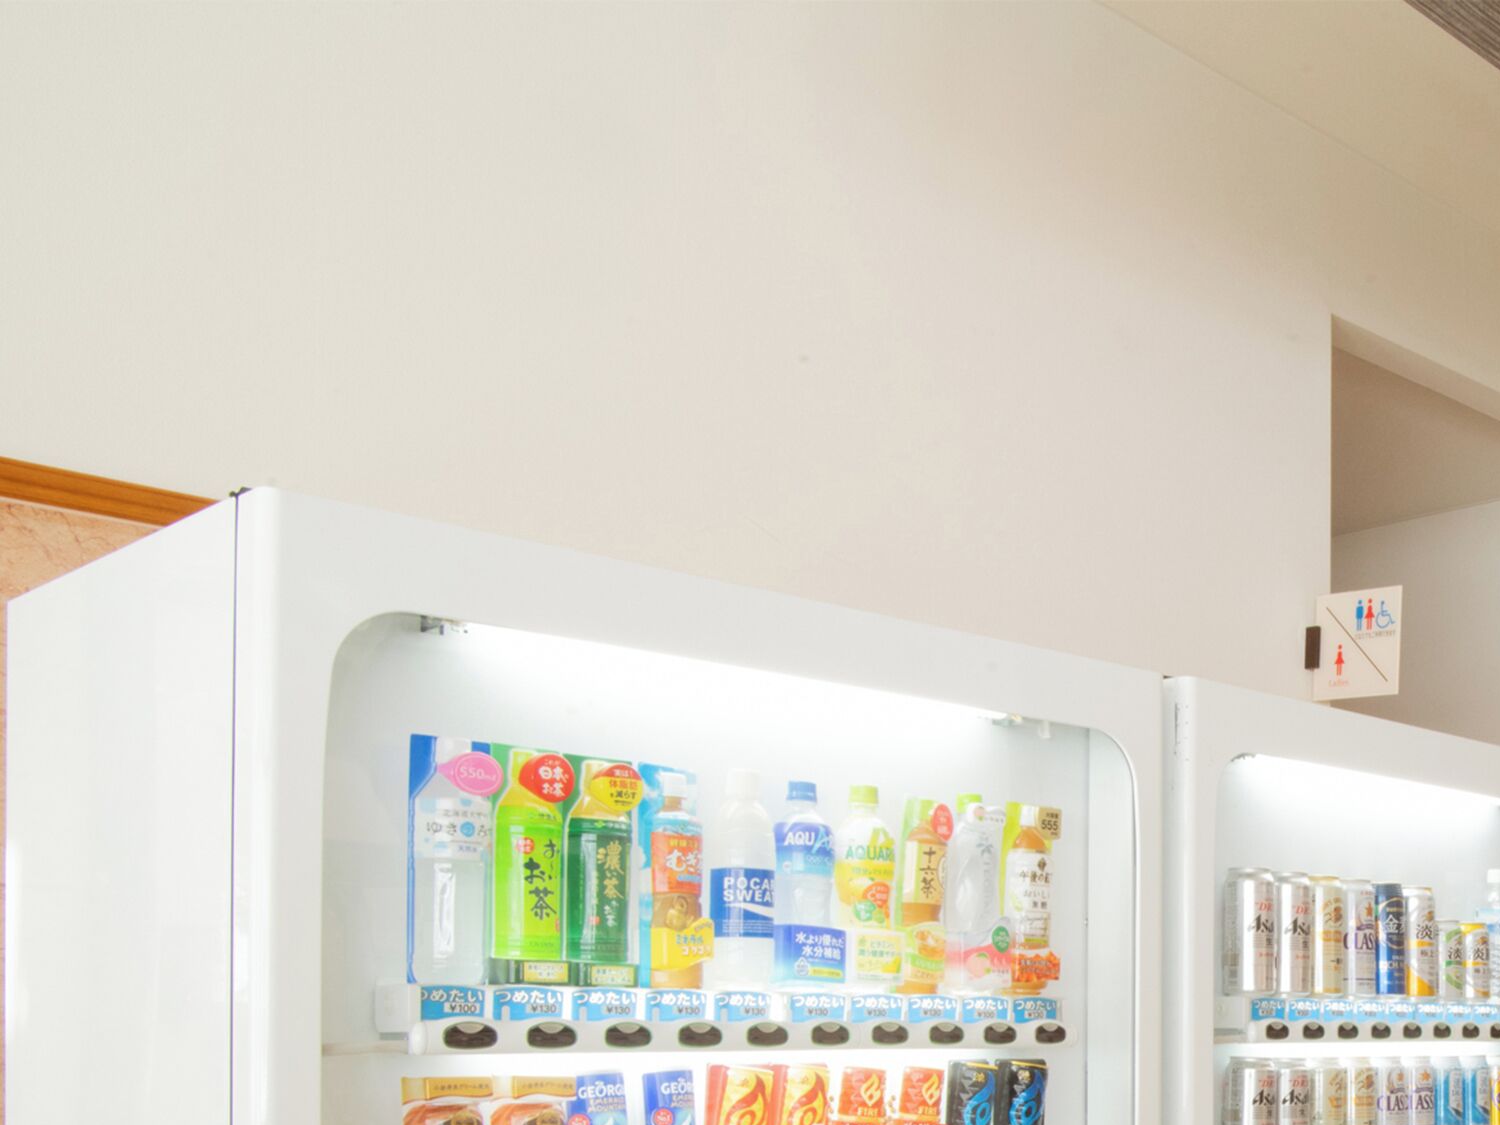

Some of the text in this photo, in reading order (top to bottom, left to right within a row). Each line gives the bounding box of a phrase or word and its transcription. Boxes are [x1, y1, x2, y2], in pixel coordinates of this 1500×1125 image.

[523, 856, 558, 921] お茶
[496, 989, 562, 1004] つめたい
[573, 990, 637, 1005] つめたい
[646, 991, 706, 1005] つめたい
[716, 994, 772, 1007] つめたい
[792, 995, 844, 1008] つめたい
[852, 996, 903, 1009] つめたい
[449, 1003, 477, 1014] ¥100
[909, 998, 958, 1009] つめたい
[963, 998, 1008, 1010] つめたい
